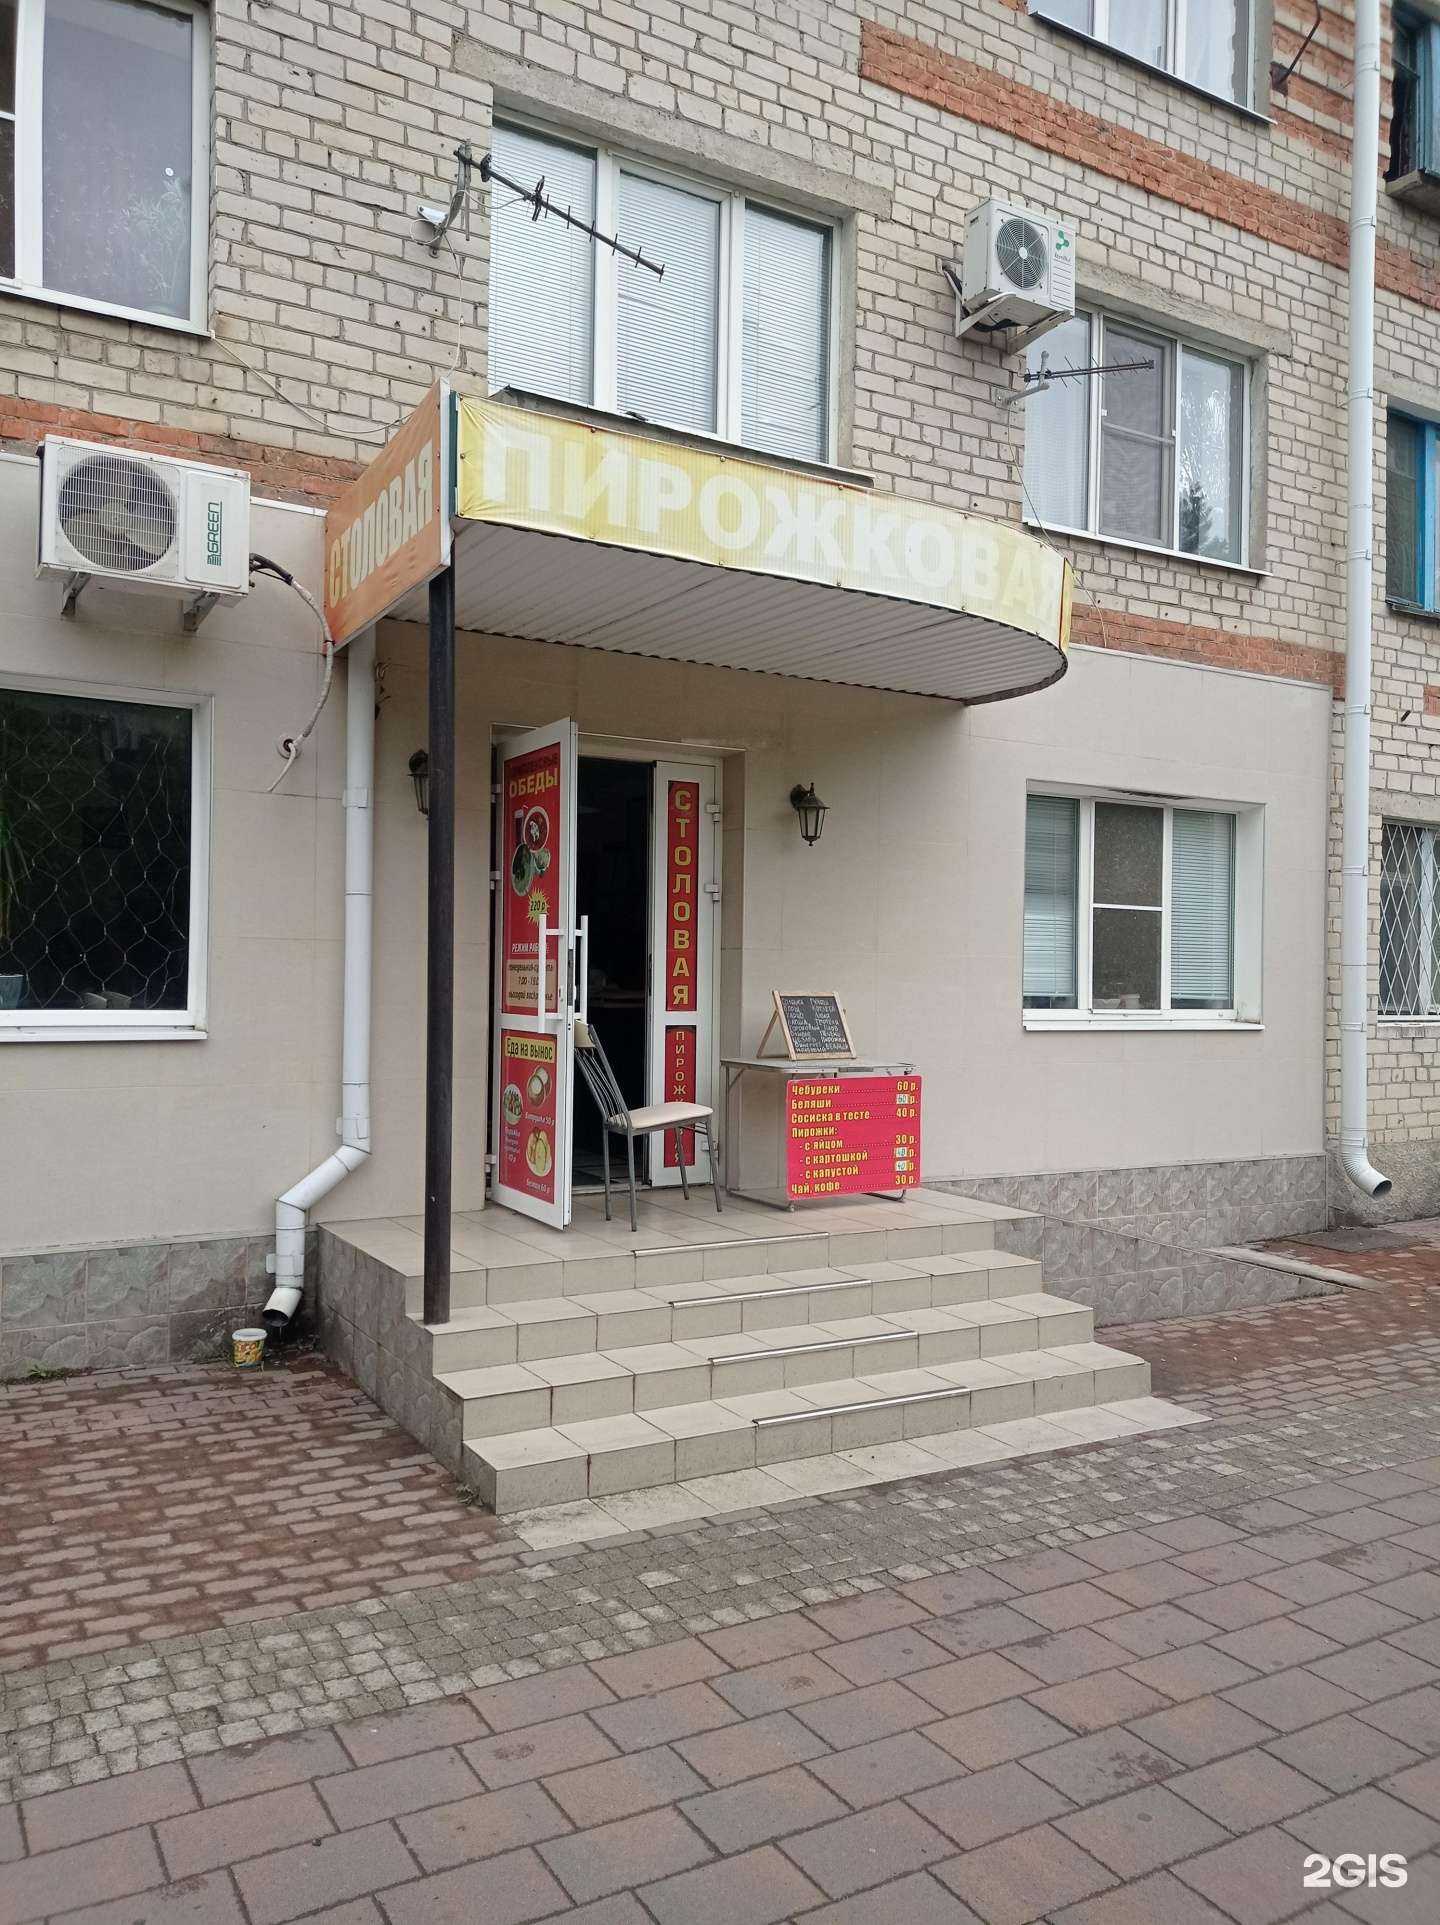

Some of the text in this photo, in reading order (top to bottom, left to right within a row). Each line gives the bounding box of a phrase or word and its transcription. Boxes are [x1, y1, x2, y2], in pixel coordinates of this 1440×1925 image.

[207, 501, 221, 554] GREEN
[329, 439, 432, 608] СТОЛОВАЯ
[482, 424, 1059, 620] ПИРОЖКОВАЯ
[509, 767, 558, 798] ОБЕДЫ
[673, 791, 691, 1005] СТОЛОВАЯ
[507, 1038, 553, 1060] Еда на вынос
[792, 1085, 840, 1095] Чебуреки
[897, 1081, 908, 1091] 60
[792, 1099, 832, 1109] Беляши
[792, 1113, 833, 1124] Сосиска
[835, 1112, 841, 1121] в
[843, 1110, 870, 1121] тесте
[896, 1107, 907, 1117] 40
[792, 1126, 838, 1138] Пирожки:
[813, 1139, 843, 1150] яйцом
[895, 1134, 907, 1145] 30
[813, 1150, 868, 1164] картошкой
[813, 1165, 859, 1179] капустой
[815, 1181, 840, 1192] кофе
[895, 1174, 907, 1185] 30
